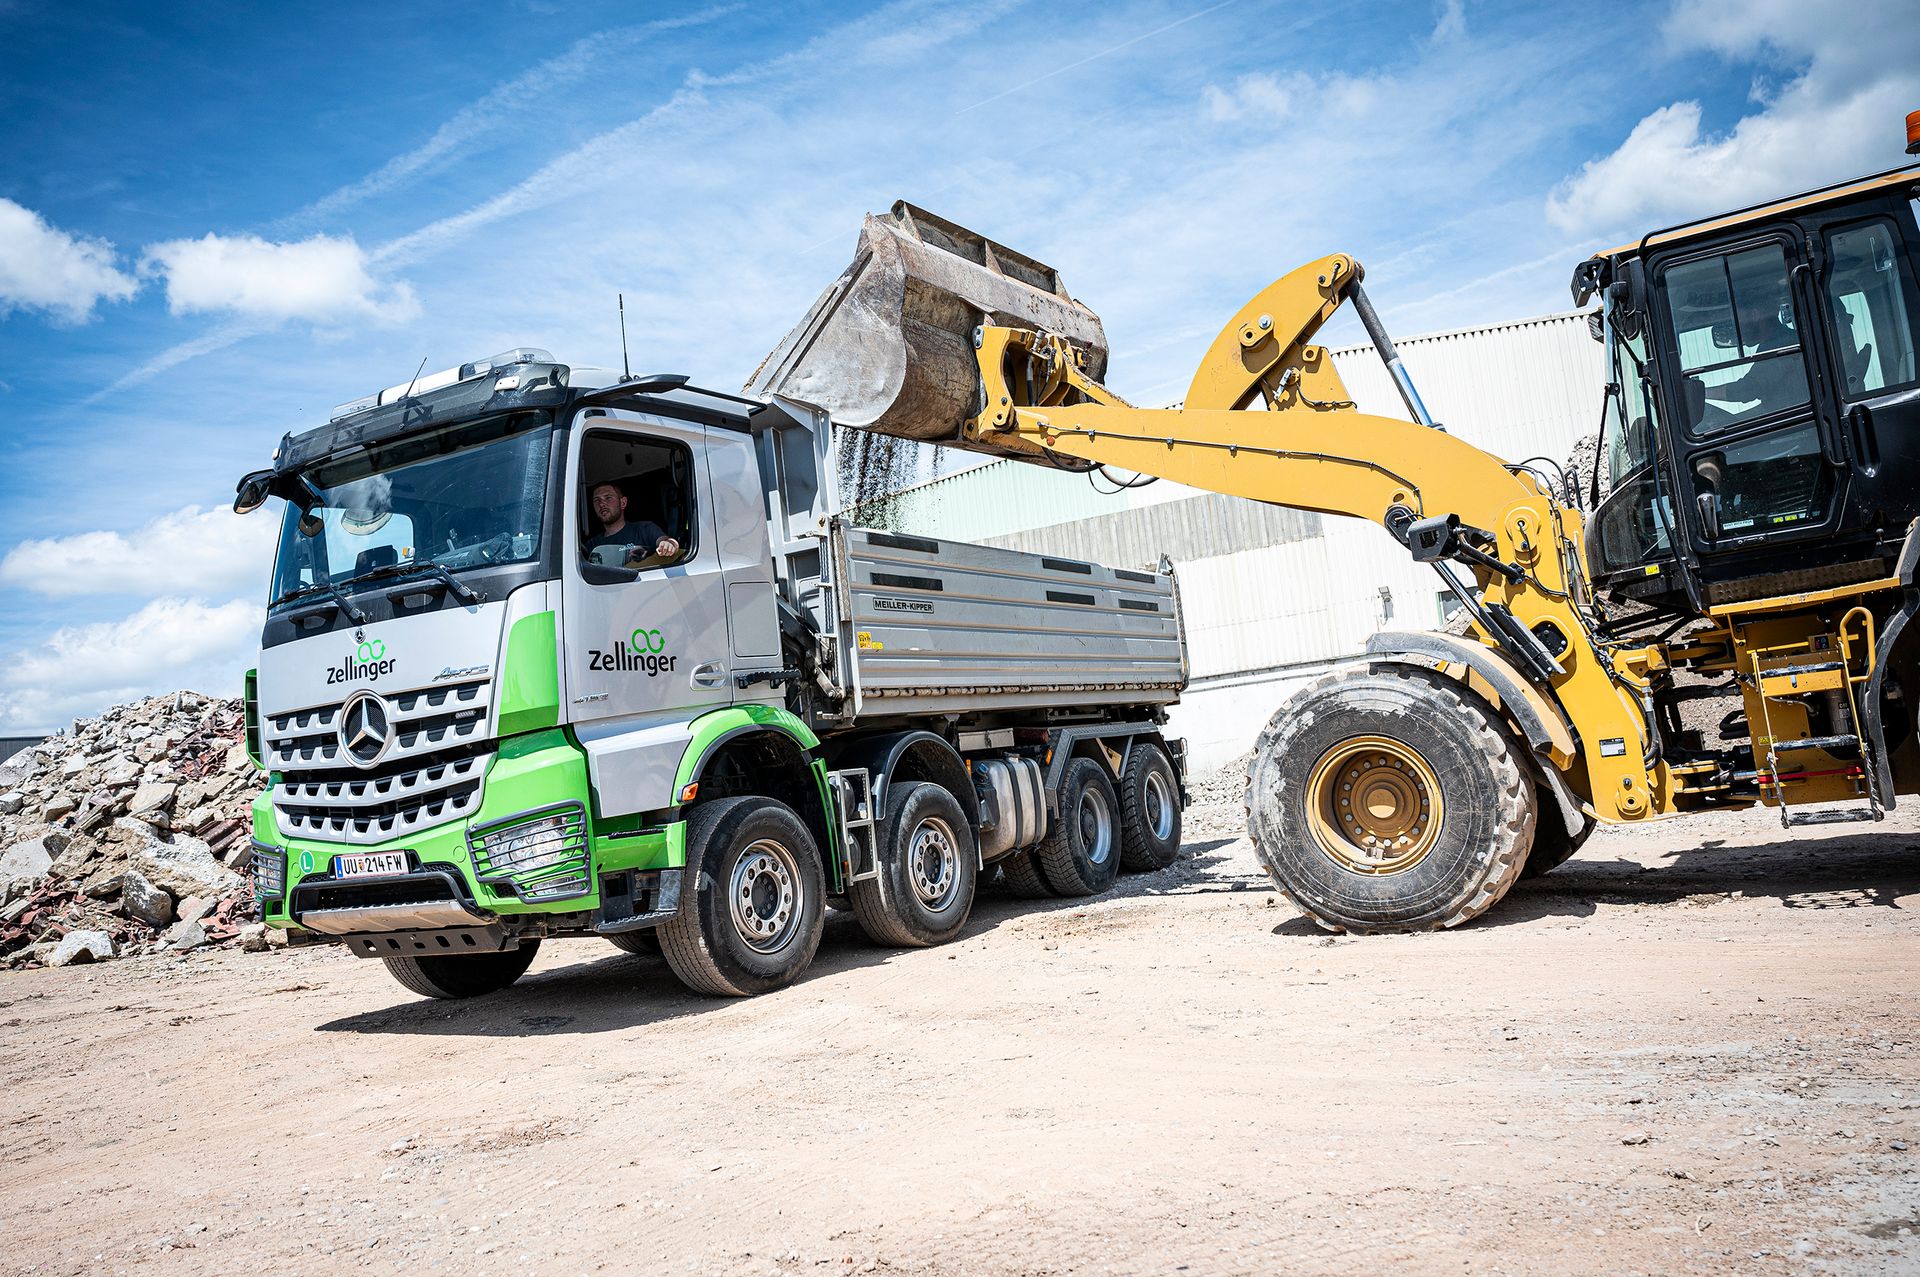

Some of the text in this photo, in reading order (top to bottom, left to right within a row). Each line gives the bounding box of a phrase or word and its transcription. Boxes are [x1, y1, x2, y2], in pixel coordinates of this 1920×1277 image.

[875, 600, 932, 611] MEILLER-KIPPER
[326, 655, 397, 685] Zellinger
[588, 641, 678, 677] Zellinger
[344, 859, 357, 874] UU
